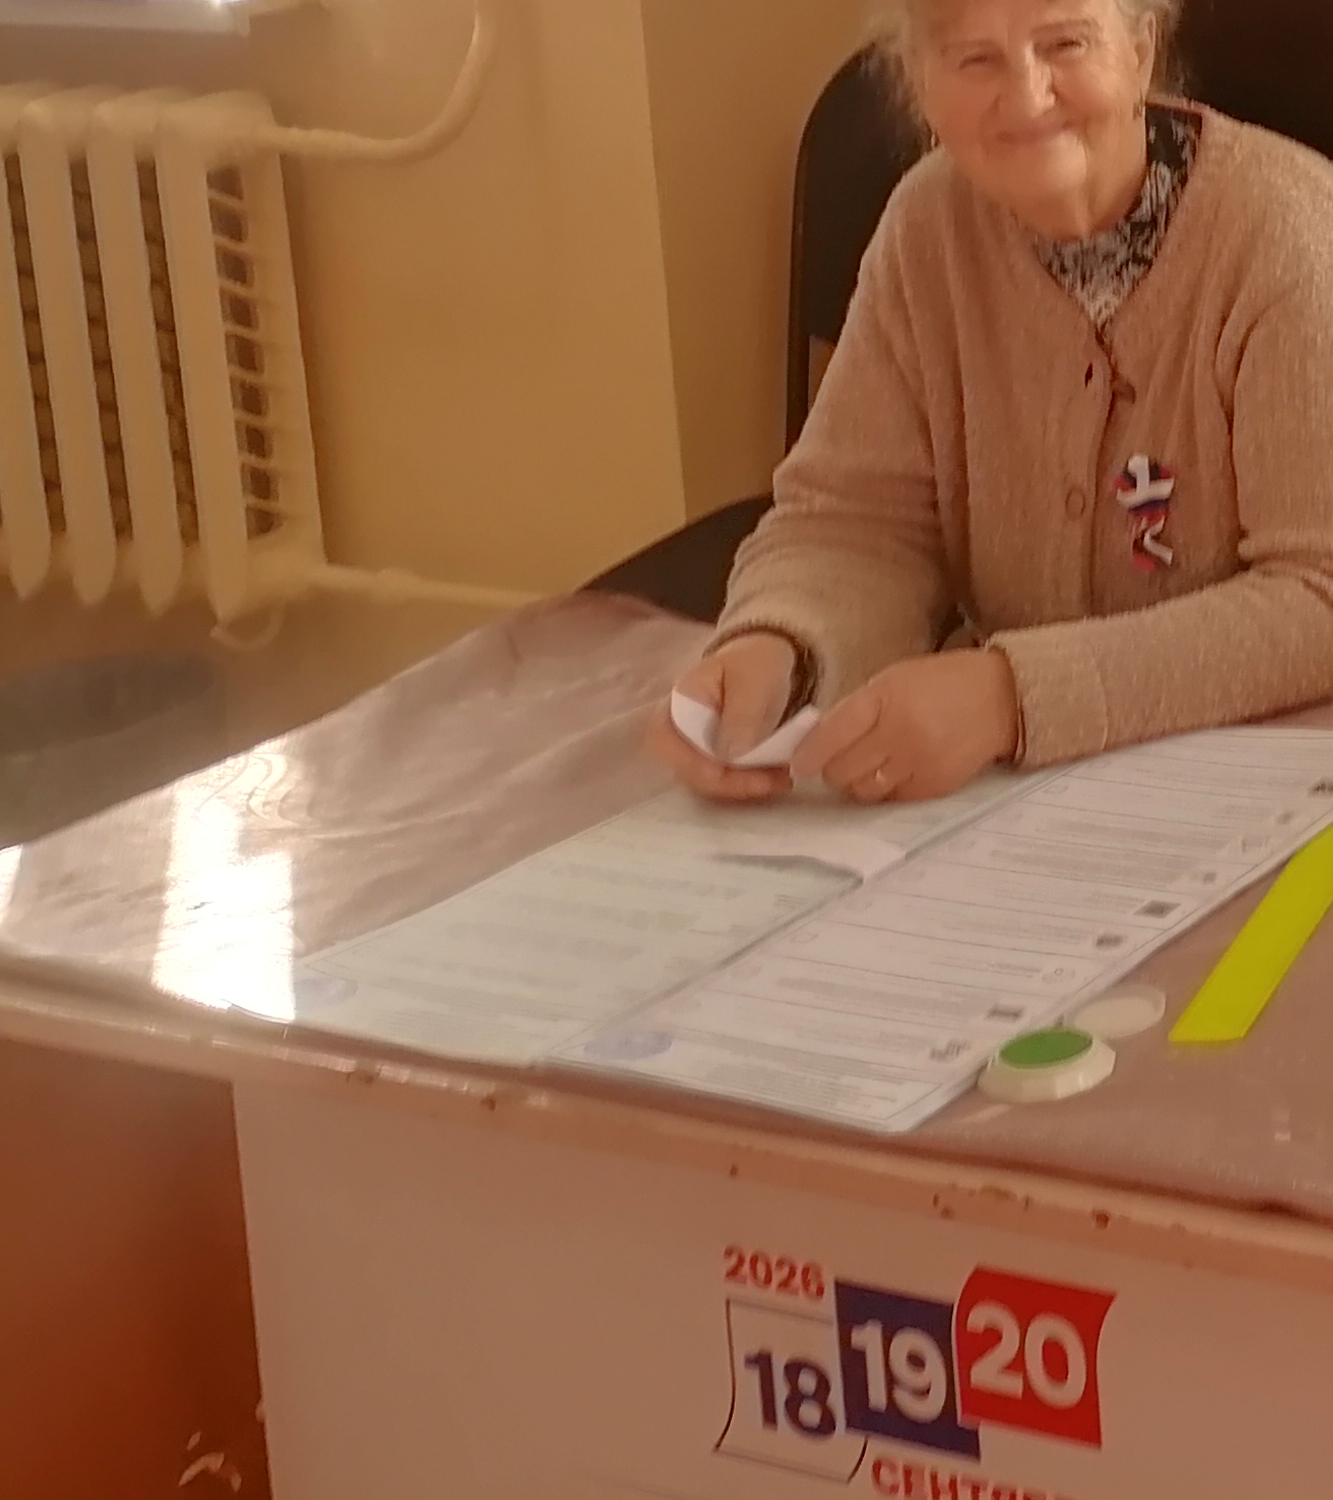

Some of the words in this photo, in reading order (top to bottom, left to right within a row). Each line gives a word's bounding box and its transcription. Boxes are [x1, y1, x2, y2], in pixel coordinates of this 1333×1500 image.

[723, 1244, 825, 1300] 2026
[744, 1348, 837, 1438] 18
[850, 1317, 948, 1424] 19
[966, 1301, 1088, 1410] 20
